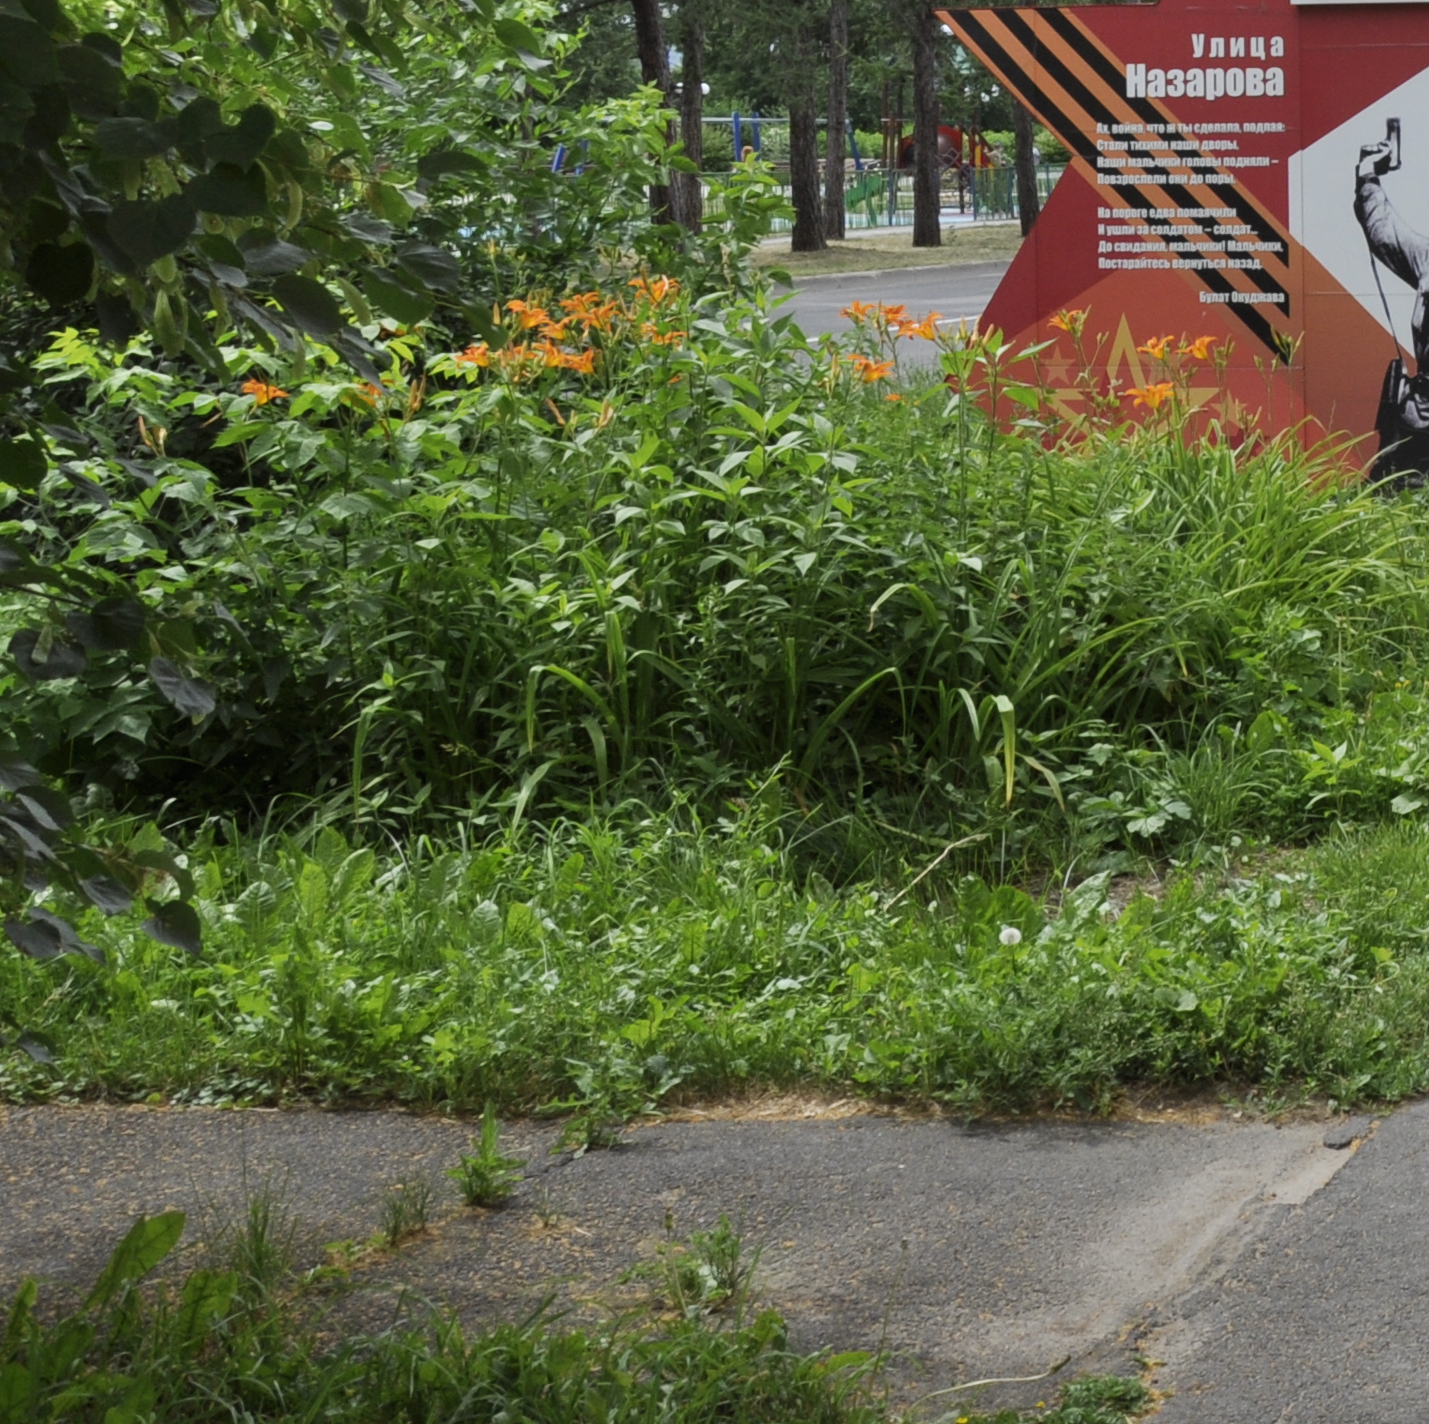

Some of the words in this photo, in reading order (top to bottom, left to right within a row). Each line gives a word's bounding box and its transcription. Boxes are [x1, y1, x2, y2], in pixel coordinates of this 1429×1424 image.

[1191, 33, 1284, 61] Улица
[1126, 63, 1284, 101] Назарова
[1147, 123, 1165, 134] что
[1177, 122, 1192, 133] ты
[1194, 122, 1242, 135] сделала,
[1097, 139, 1129, 151] Стали
[1130, 140, 1169, 151] тихими
[1170, 140, 1200, 151] наши
[1097, 156, 1127, 168] Наши
[1127, 157, 1181, 168] мальчики
[1182, 156, 1222, 168] головы
[1223, 156, 1270, 169] подняли
[1168, 174, 1188, 185] они
[1189, 173, 1204, 186] до
[1097, 206, 1111, 219] На
[1112, 207, 1148, 219] пороге
[1149, 207, 1175, 220] едва
[1097, 223, 1105, 235] И
[1106, 224, 1136, 236] ушли
[1136, 225, 1150, 235] за
[1150, 225, 1203, 236] солдатом
[1098, 240, 1113, 254] До
[1098, 256, 1171, 270] Постарайтесь
[1172, 258, 1226, 270] вернуться
[1199, 290, 1230, 304] Булат
[1231, 290, 1285, 304] Окуджава
